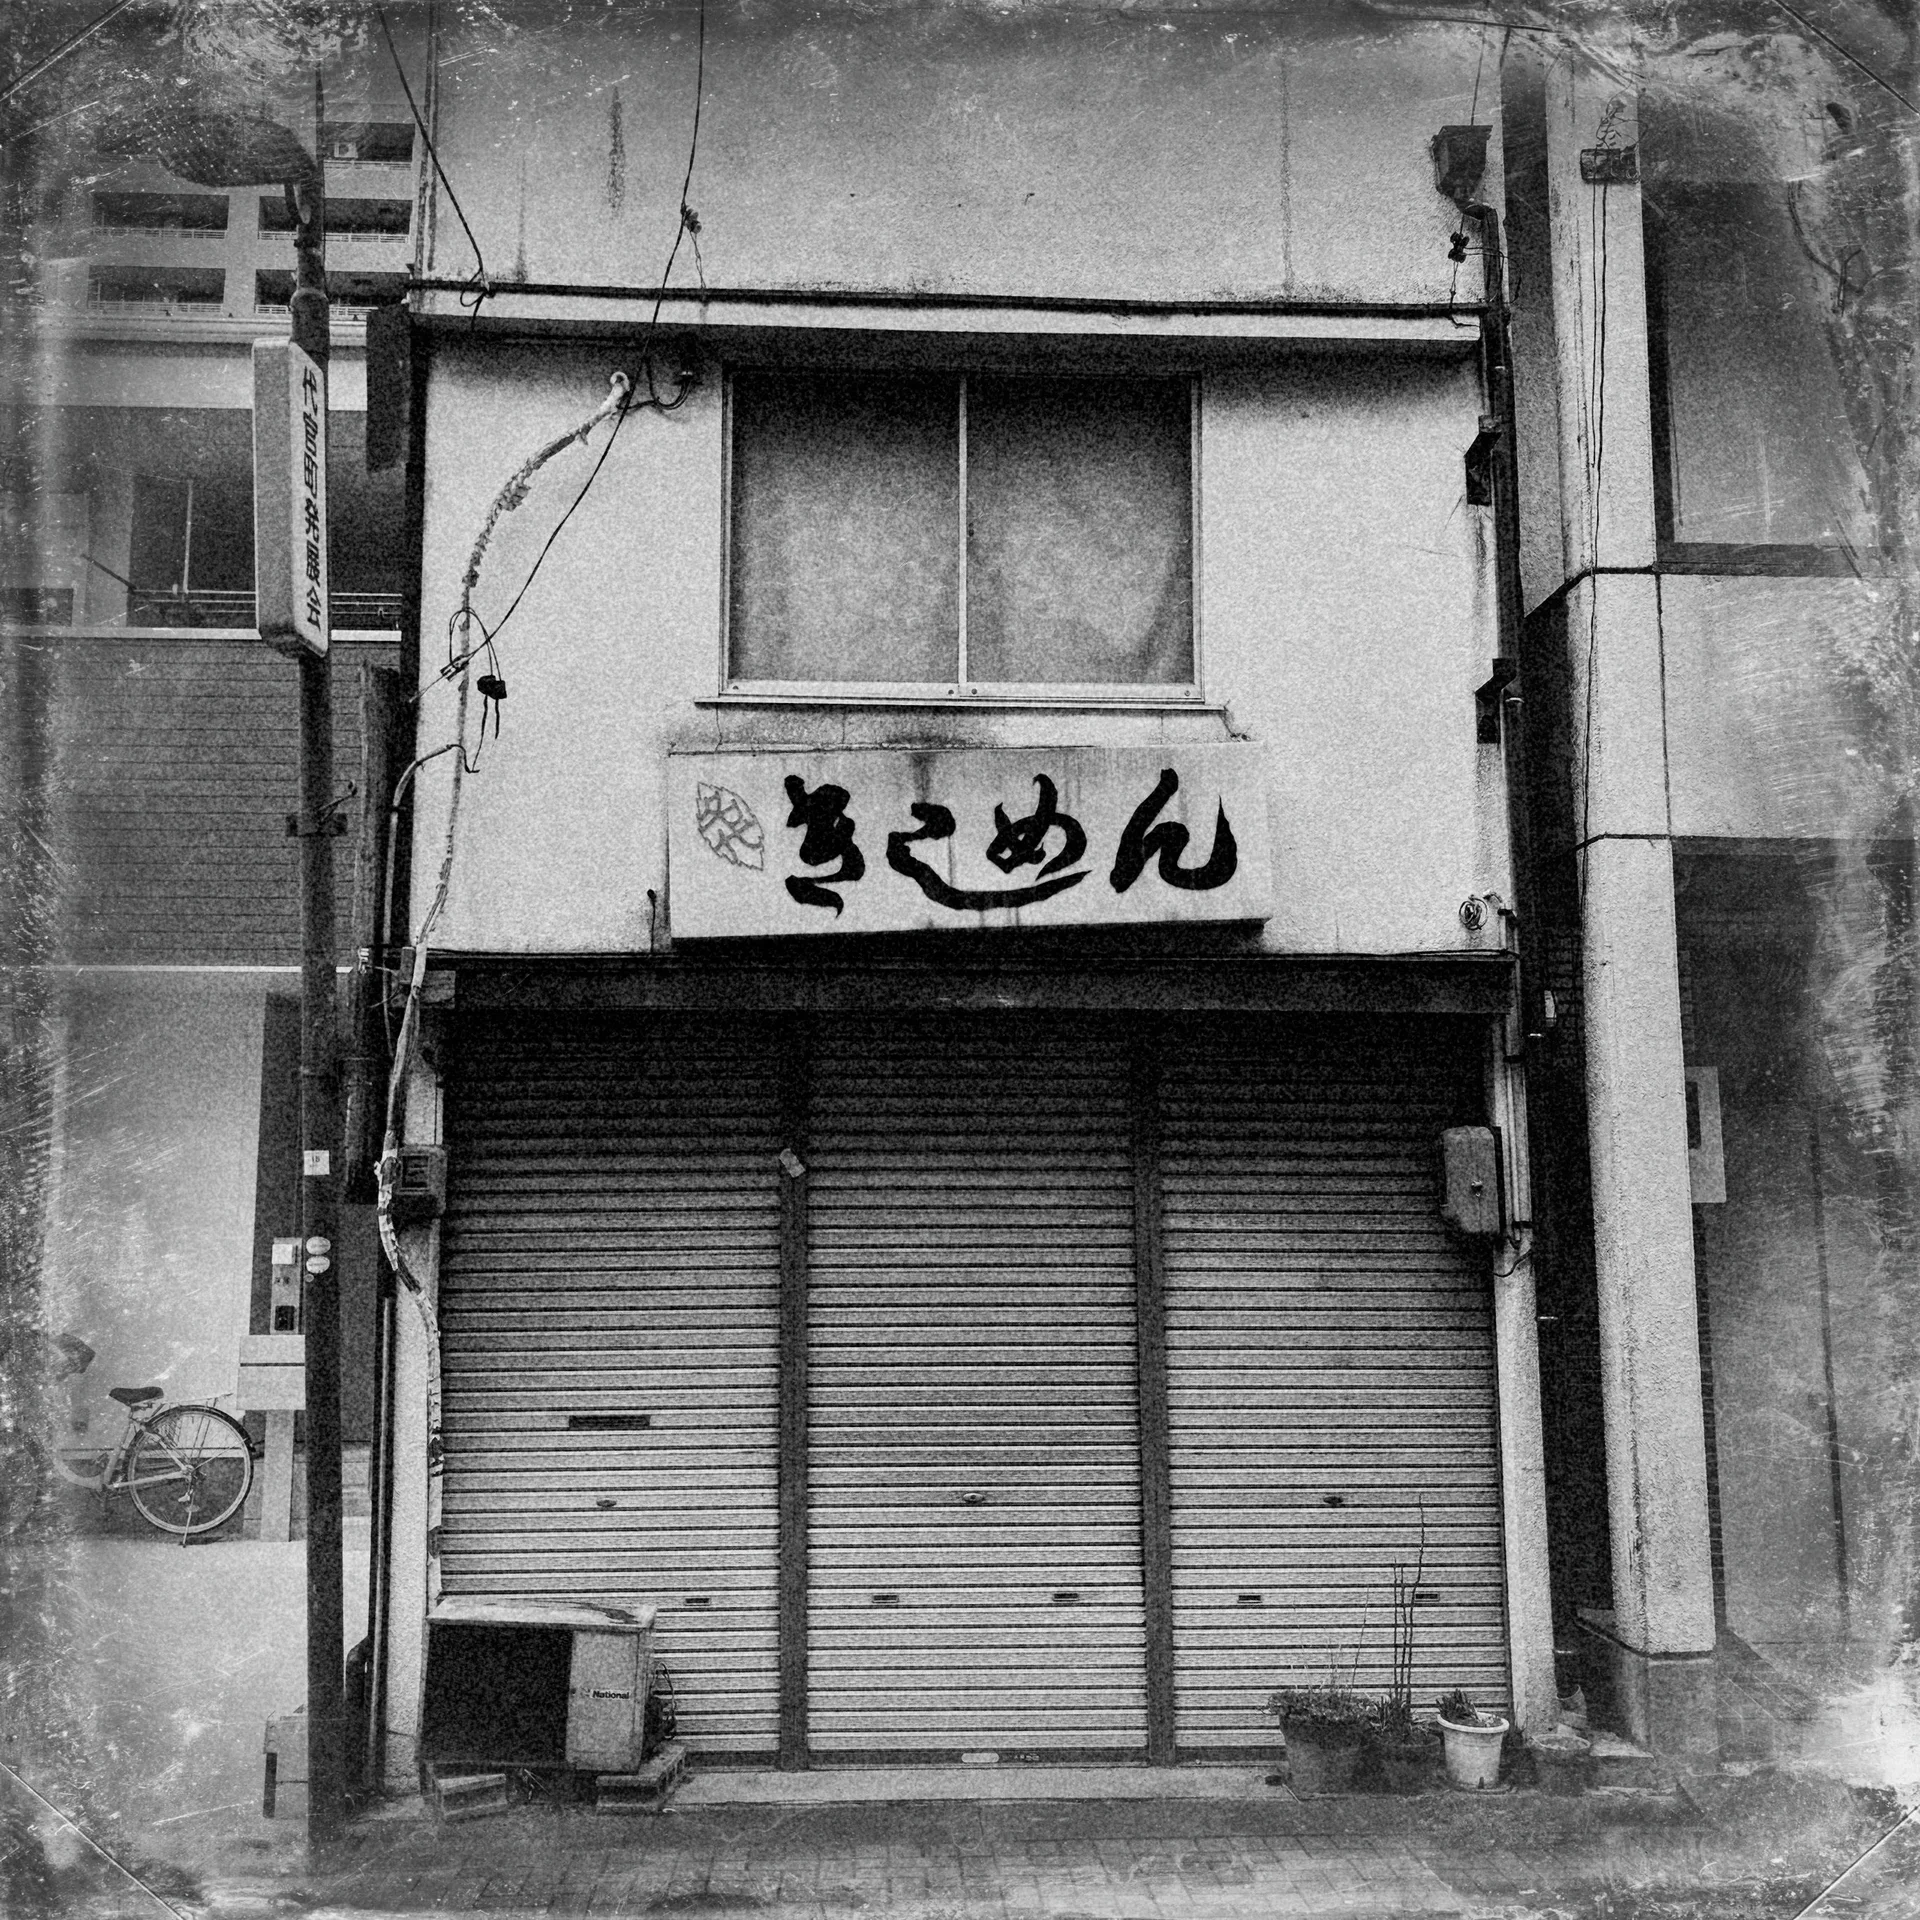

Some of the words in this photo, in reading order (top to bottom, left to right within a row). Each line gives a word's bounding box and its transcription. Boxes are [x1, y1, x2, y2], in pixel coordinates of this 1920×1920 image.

[302, 365, 321, 632] 代官町発展会
[592, 1690, 630, 1699] National
